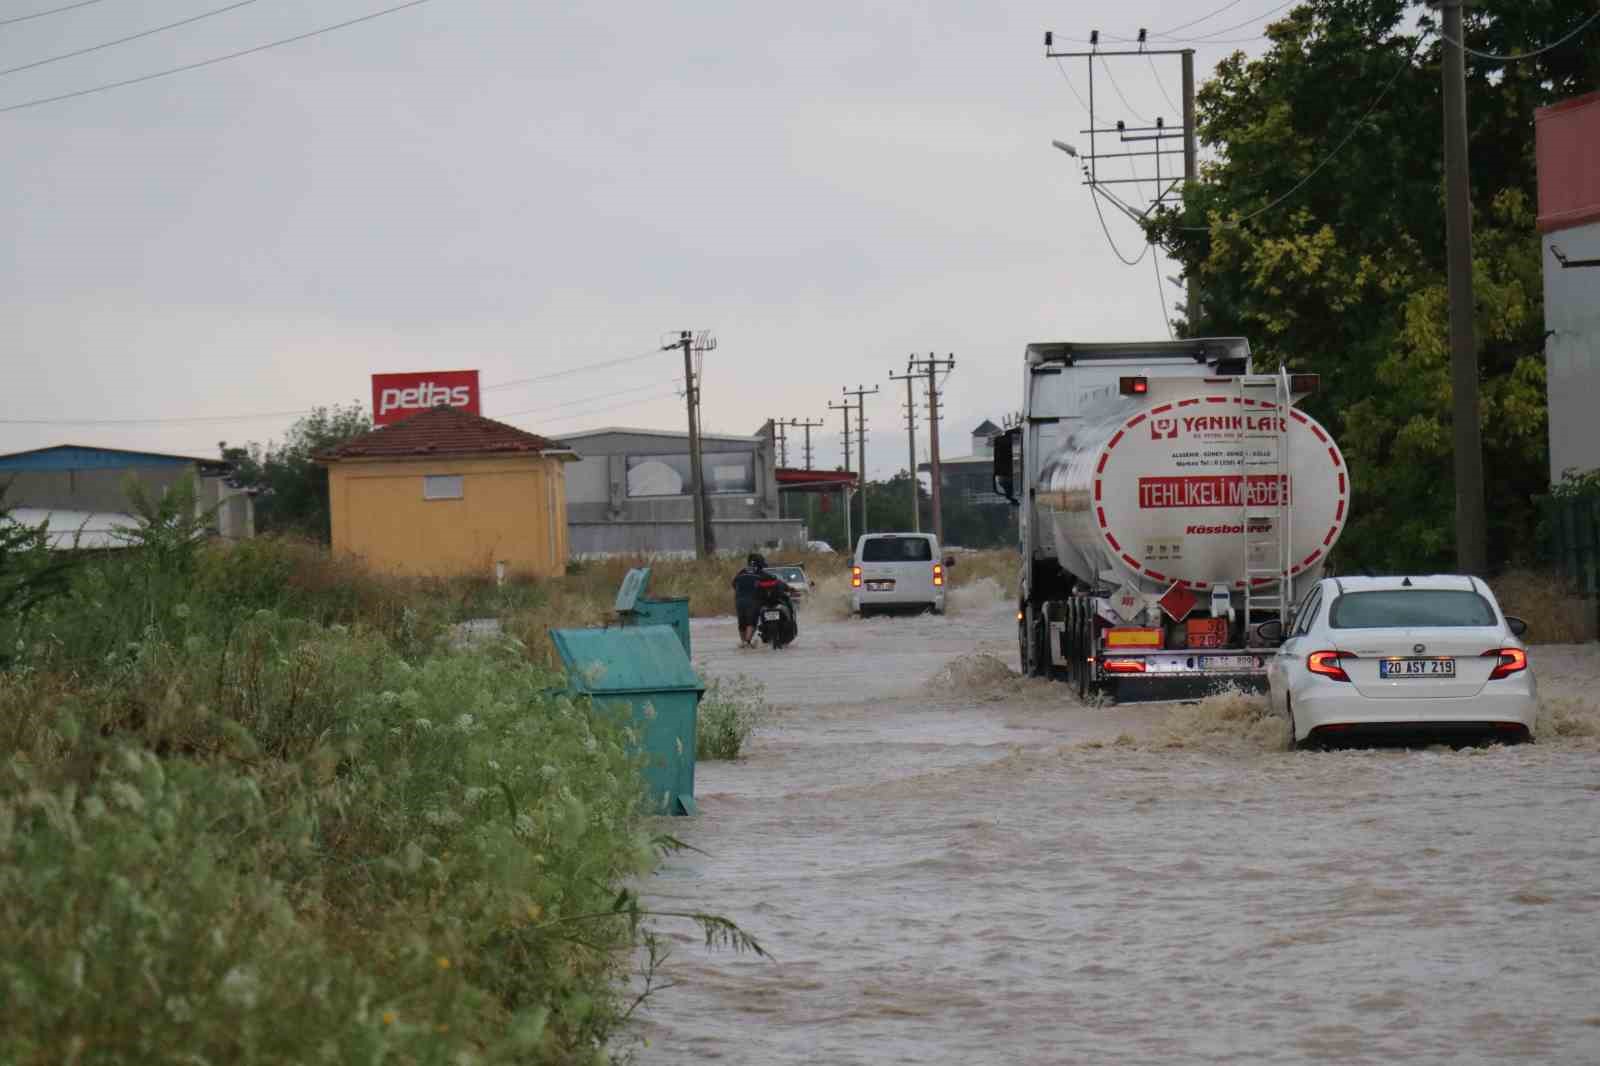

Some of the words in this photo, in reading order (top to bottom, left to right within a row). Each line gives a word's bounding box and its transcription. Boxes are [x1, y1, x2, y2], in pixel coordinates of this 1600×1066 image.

[1183, 416, 1287, 433] YANIKLAR
[1141, 479, 1225, 507] TEHLİKELİ
[1388, 662, 1401, 673] 20
[1407, 661, 1425, 673] ASY
[1432, 661, 1452, 673] 219
